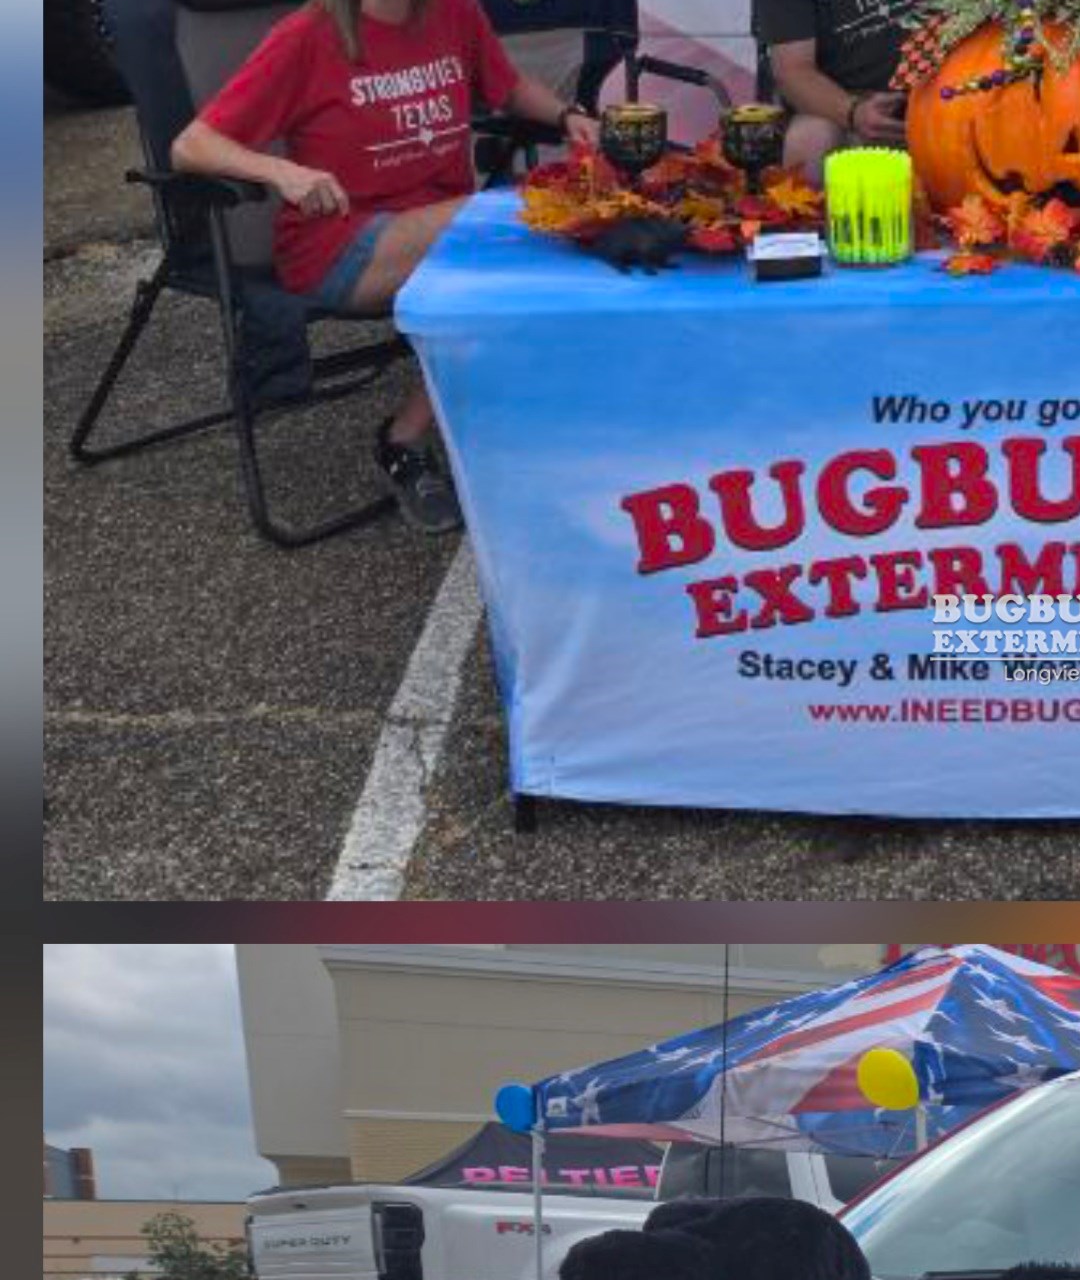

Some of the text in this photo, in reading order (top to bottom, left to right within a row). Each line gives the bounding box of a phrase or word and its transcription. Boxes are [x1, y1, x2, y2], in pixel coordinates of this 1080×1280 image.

[391, 94, 453, 131] TEXAS
[872, 395, 951, 423] Who
[962, 398, 1025, 429] you
[738, 651, 858, 687] Stacey
[870, 654, 895, 681] &
[907, 653, 990, 681] Mike
[263, 1235, 351, 1249] SUPER DUTY
